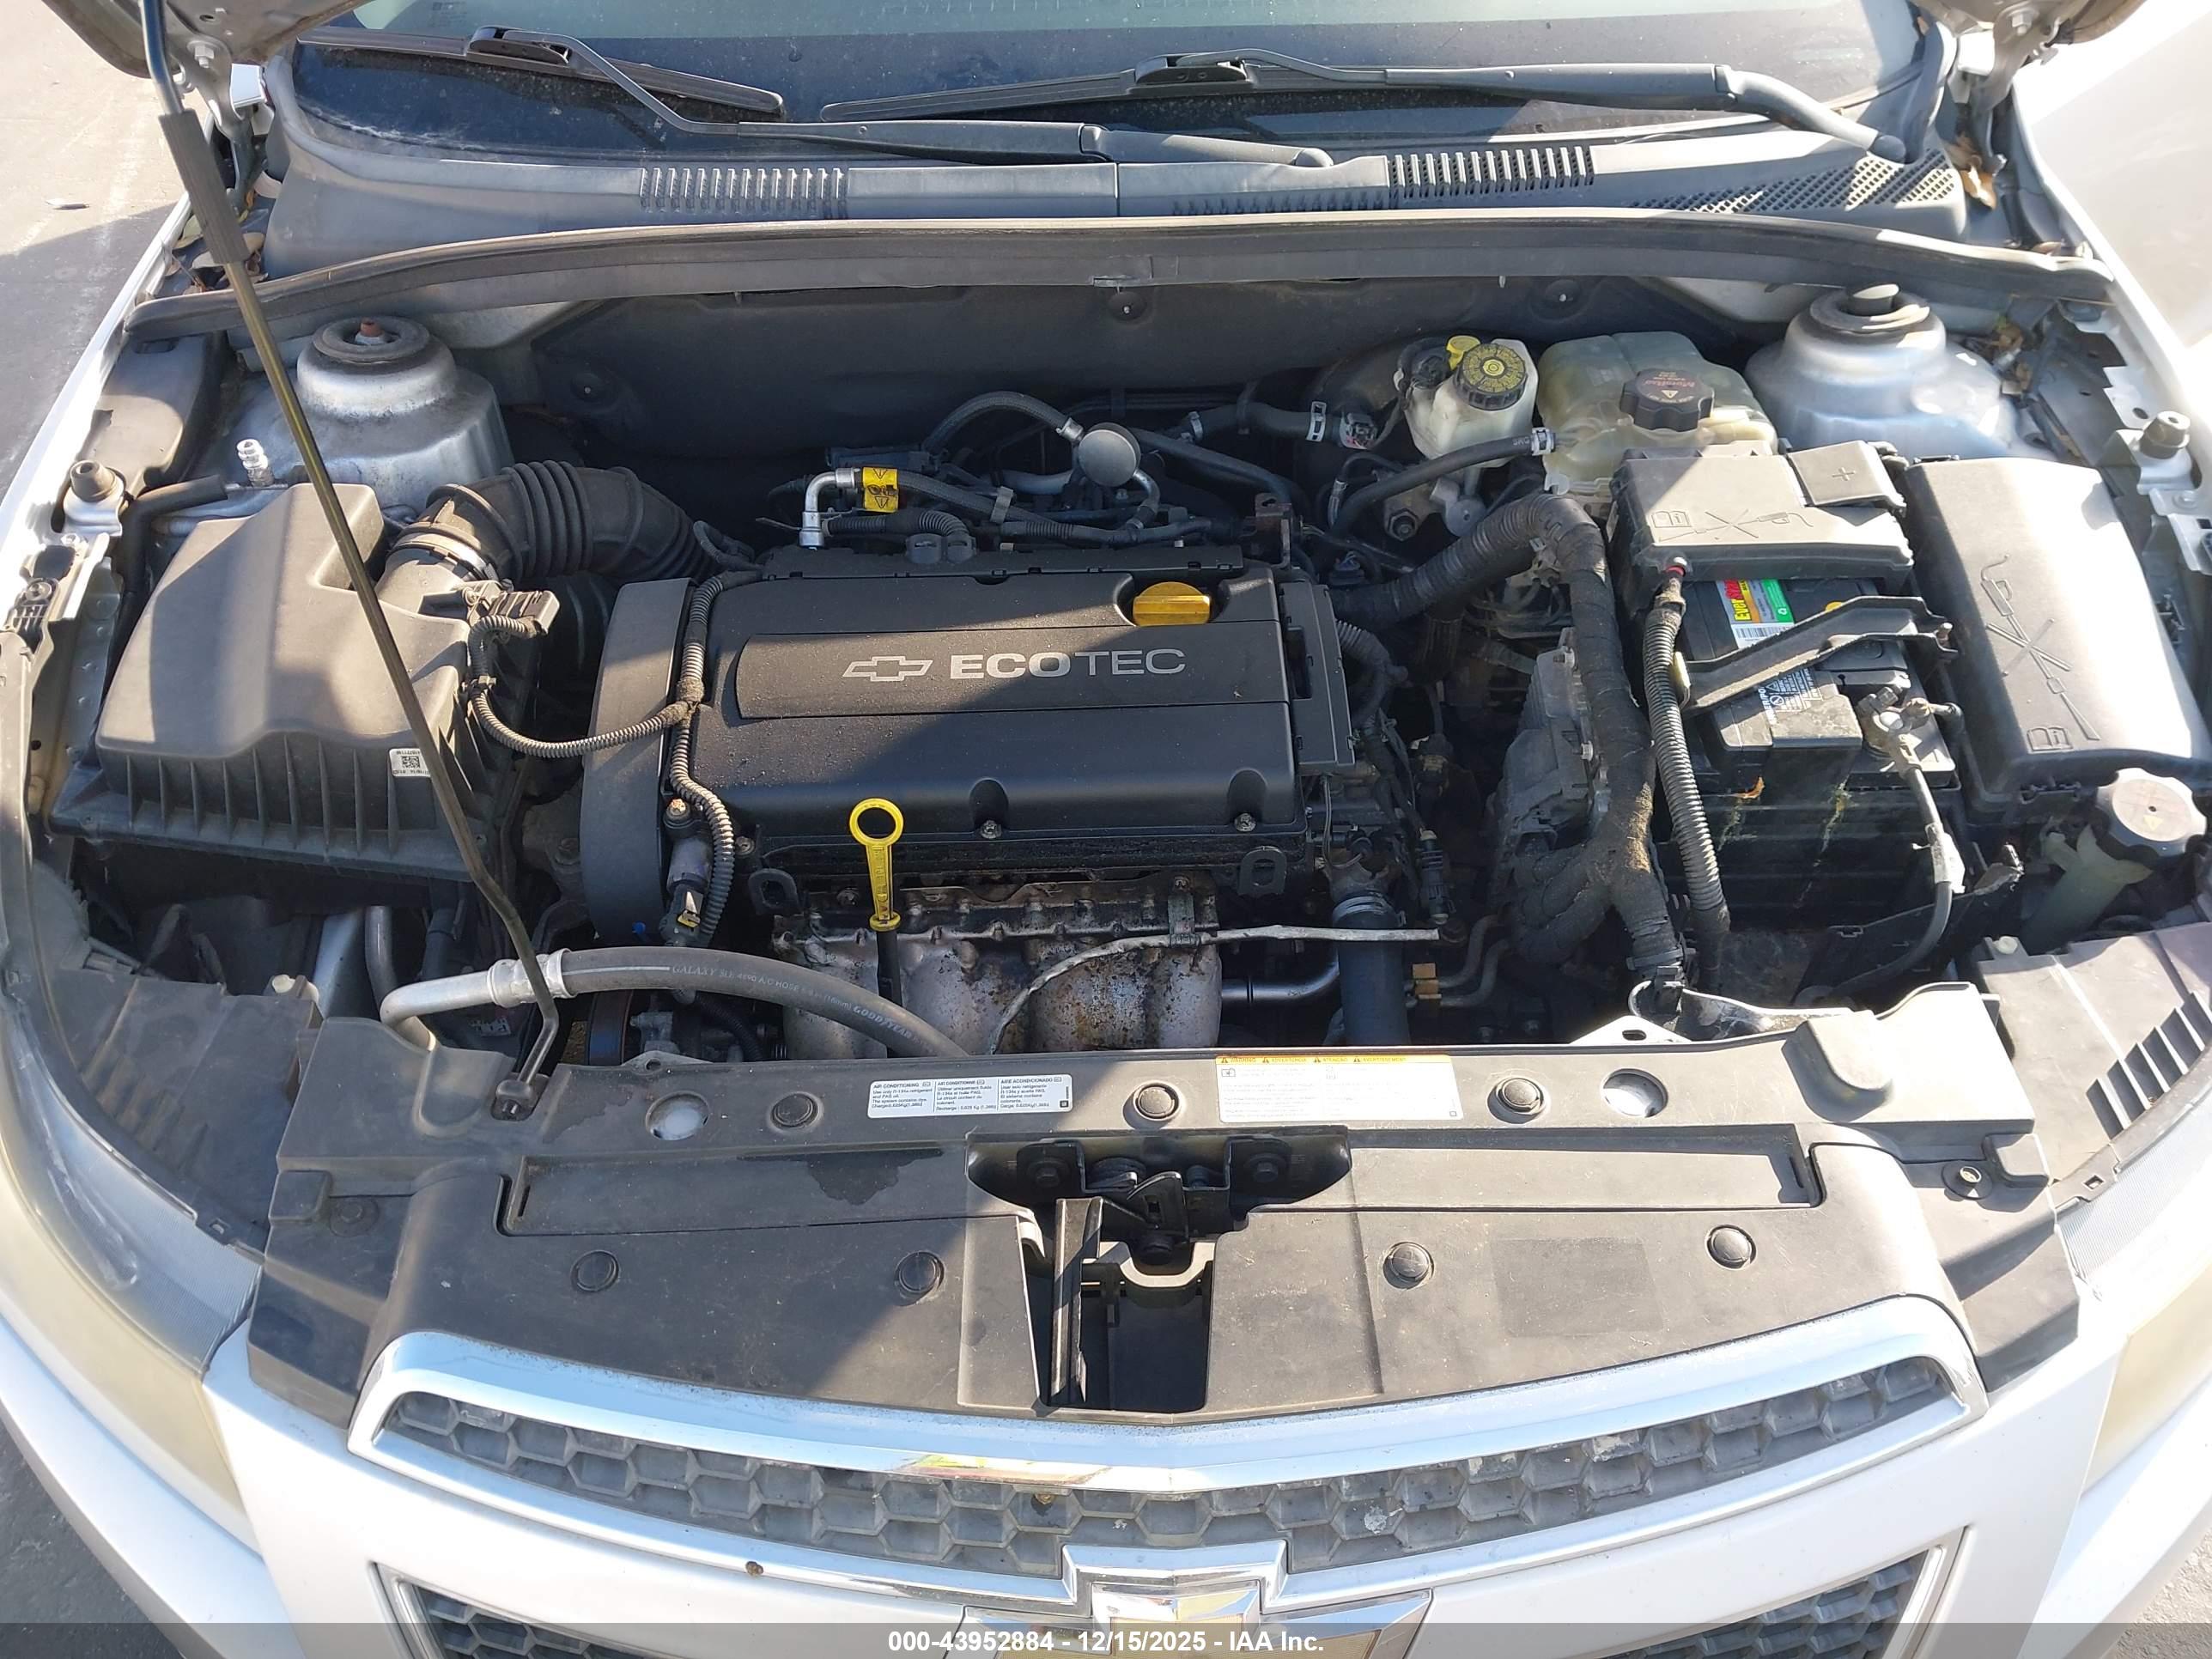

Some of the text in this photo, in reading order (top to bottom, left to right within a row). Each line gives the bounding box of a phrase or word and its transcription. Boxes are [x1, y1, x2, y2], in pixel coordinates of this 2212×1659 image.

[951, 648, 1186, 679] ECOTEC
[672, 965, 715, 976] GALAXY
[853, 1005, 913, 1040] GOODYEAR
